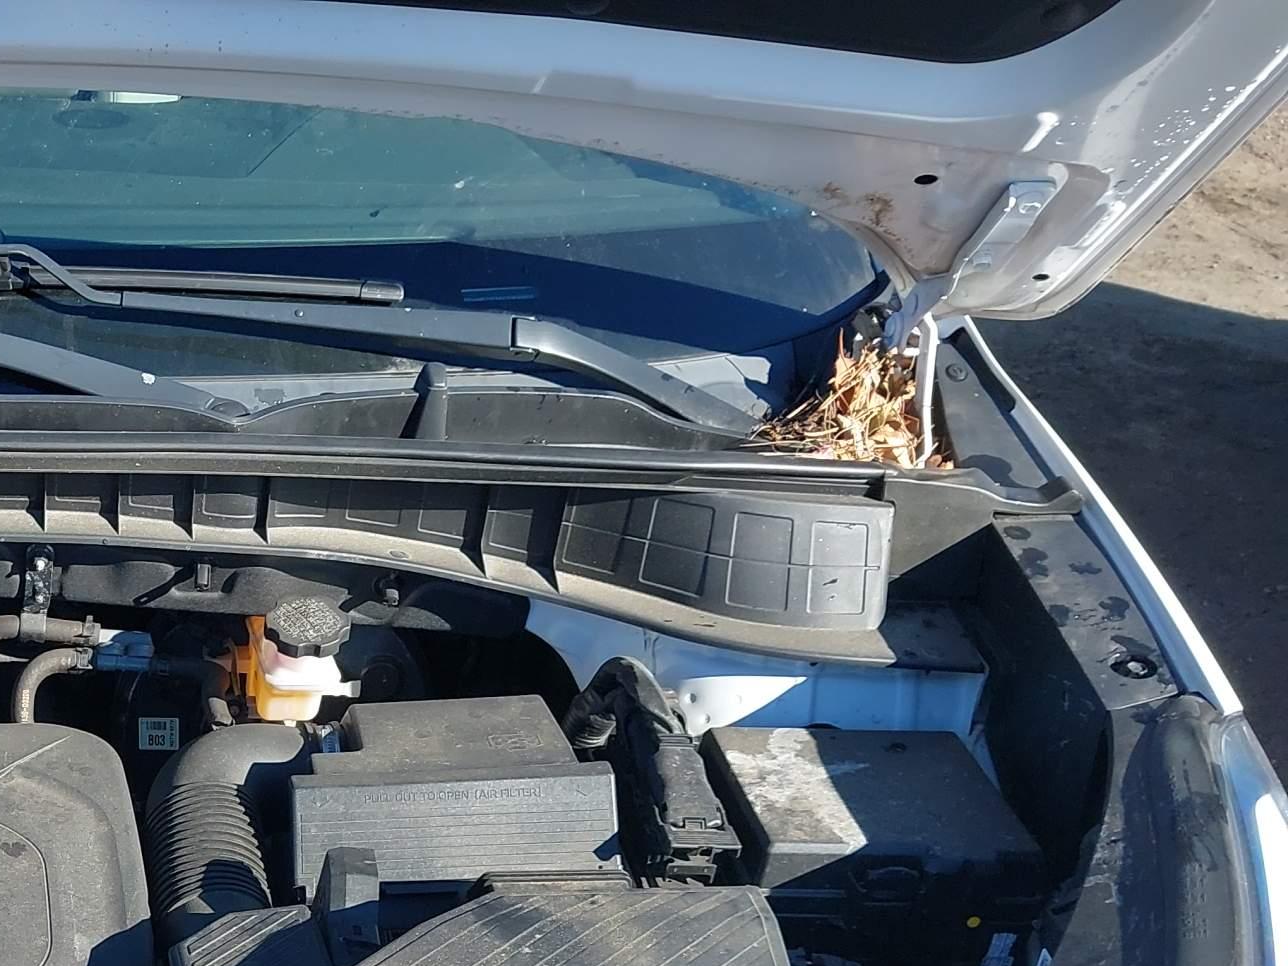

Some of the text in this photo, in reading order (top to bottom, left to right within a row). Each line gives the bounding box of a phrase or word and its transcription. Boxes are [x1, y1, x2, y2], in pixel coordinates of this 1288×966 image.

[395, 792, 418, 802] OUT
[422, 791, 436, 801] TO
[438, 790, 470, 801] OPEN
